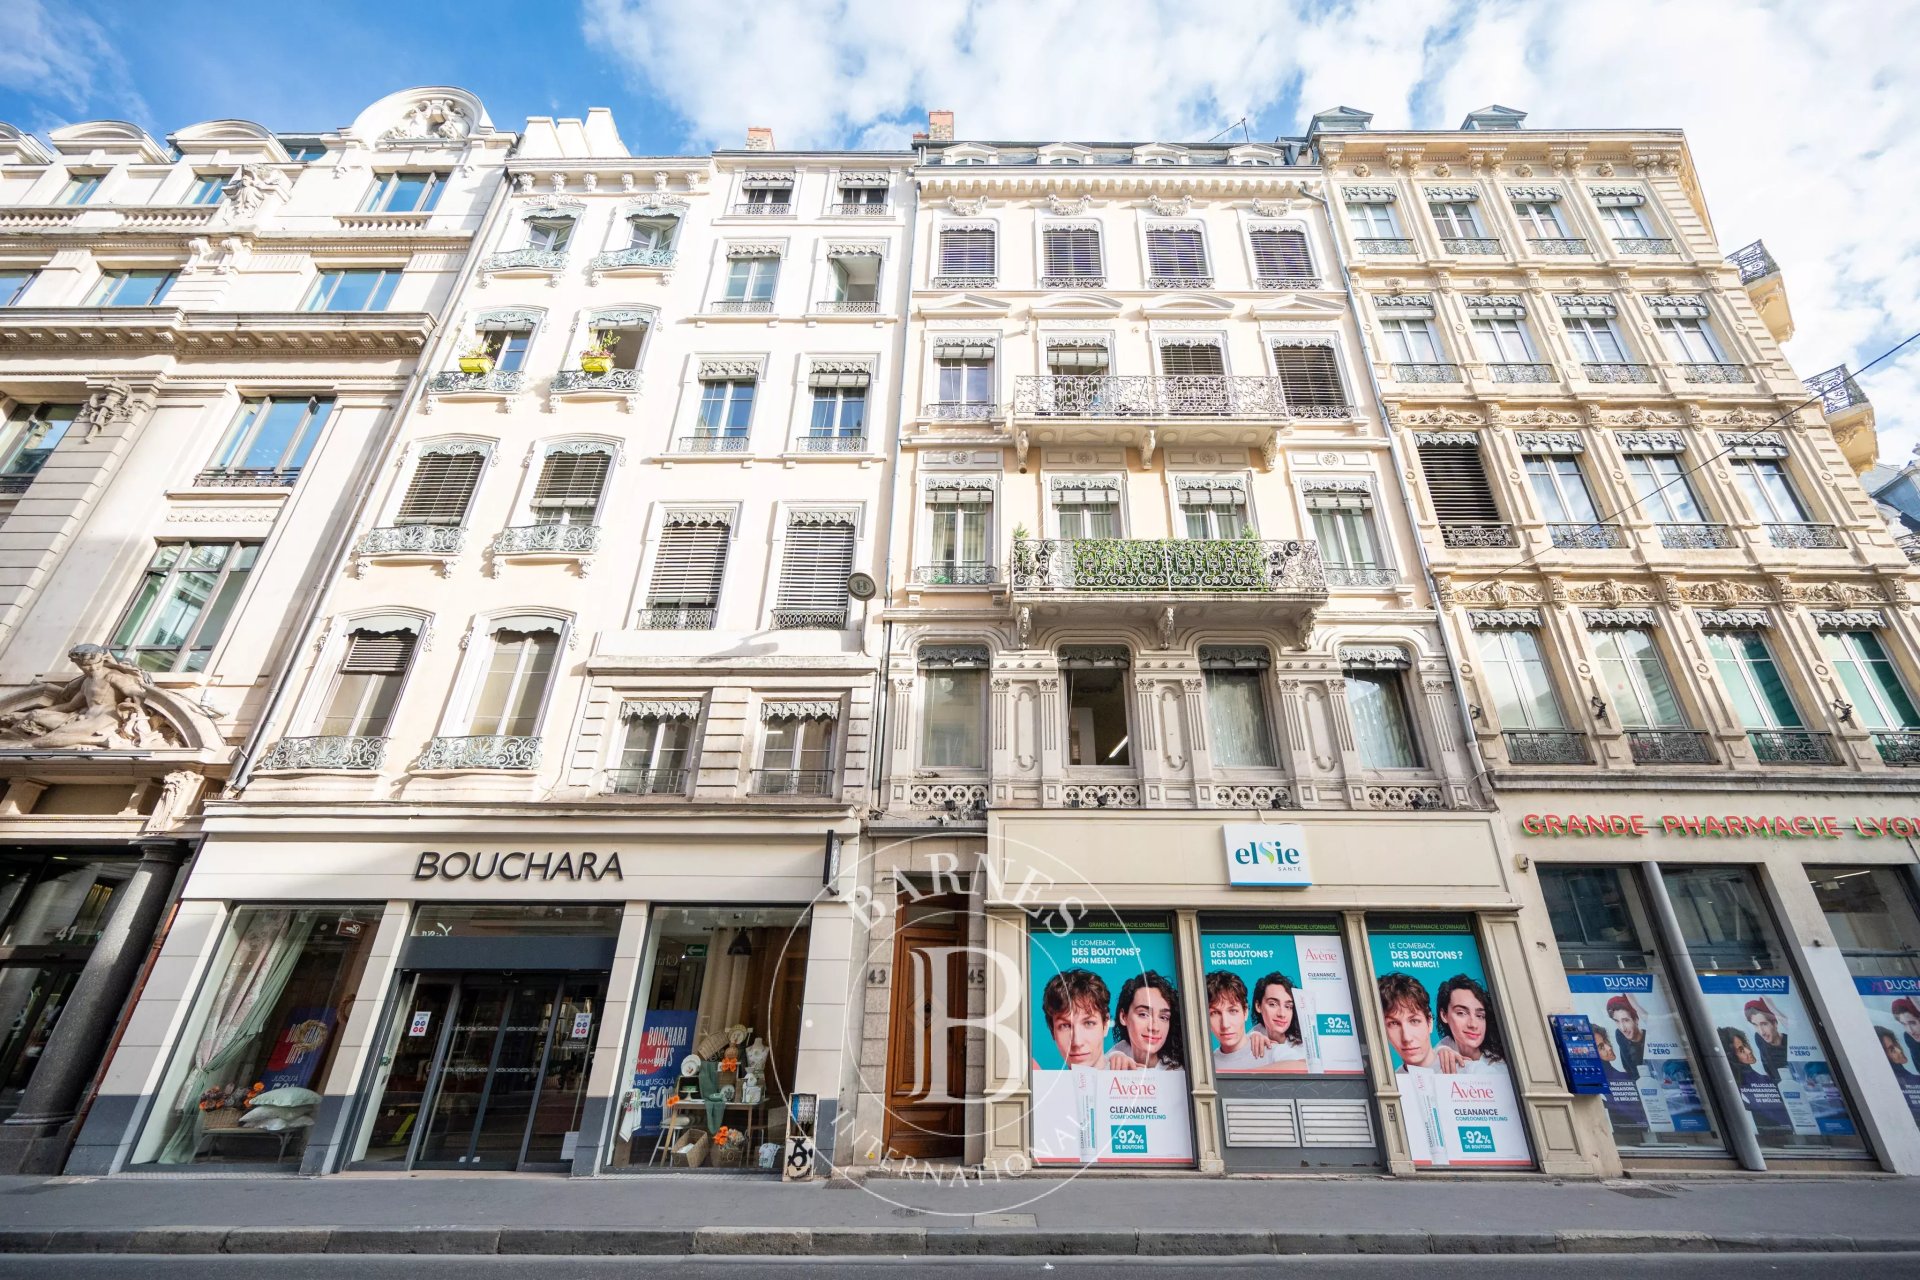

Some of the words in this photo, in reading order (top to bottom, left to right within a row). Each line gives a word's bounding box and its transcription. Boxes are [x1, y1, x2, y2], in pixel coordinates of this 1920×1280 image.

[1522, 814, 1648, 834] GRANDE
[1661, 815, 1843, 837] PHARMACIE
[414, 851, 624, 881] BOUCHARA
[55, 926, 77, 940] 41
[1072, 948, 1089, 956] DES
[1305, 948, 1337, 961] Avène
[1391, 951, 1409, 959] DES
[868, 969, 887, 984] 43
[968, 969, 985, 983] 45
[1603, 977, 1648, 987] DUCRAY
[1738, 978, 1784, 988] DUCRAY
[1324, 1017, 1350, 1029] -92%
[647, 1027, 687, 1046] BOUCHARA
[654, 1048, 674, 1067] DAYS
[1109, 1077, 1156, 1095] Avène
[1451, 1081, 1494, 1098] Avène
[1463, 1131, 1491, 1144] -92%
